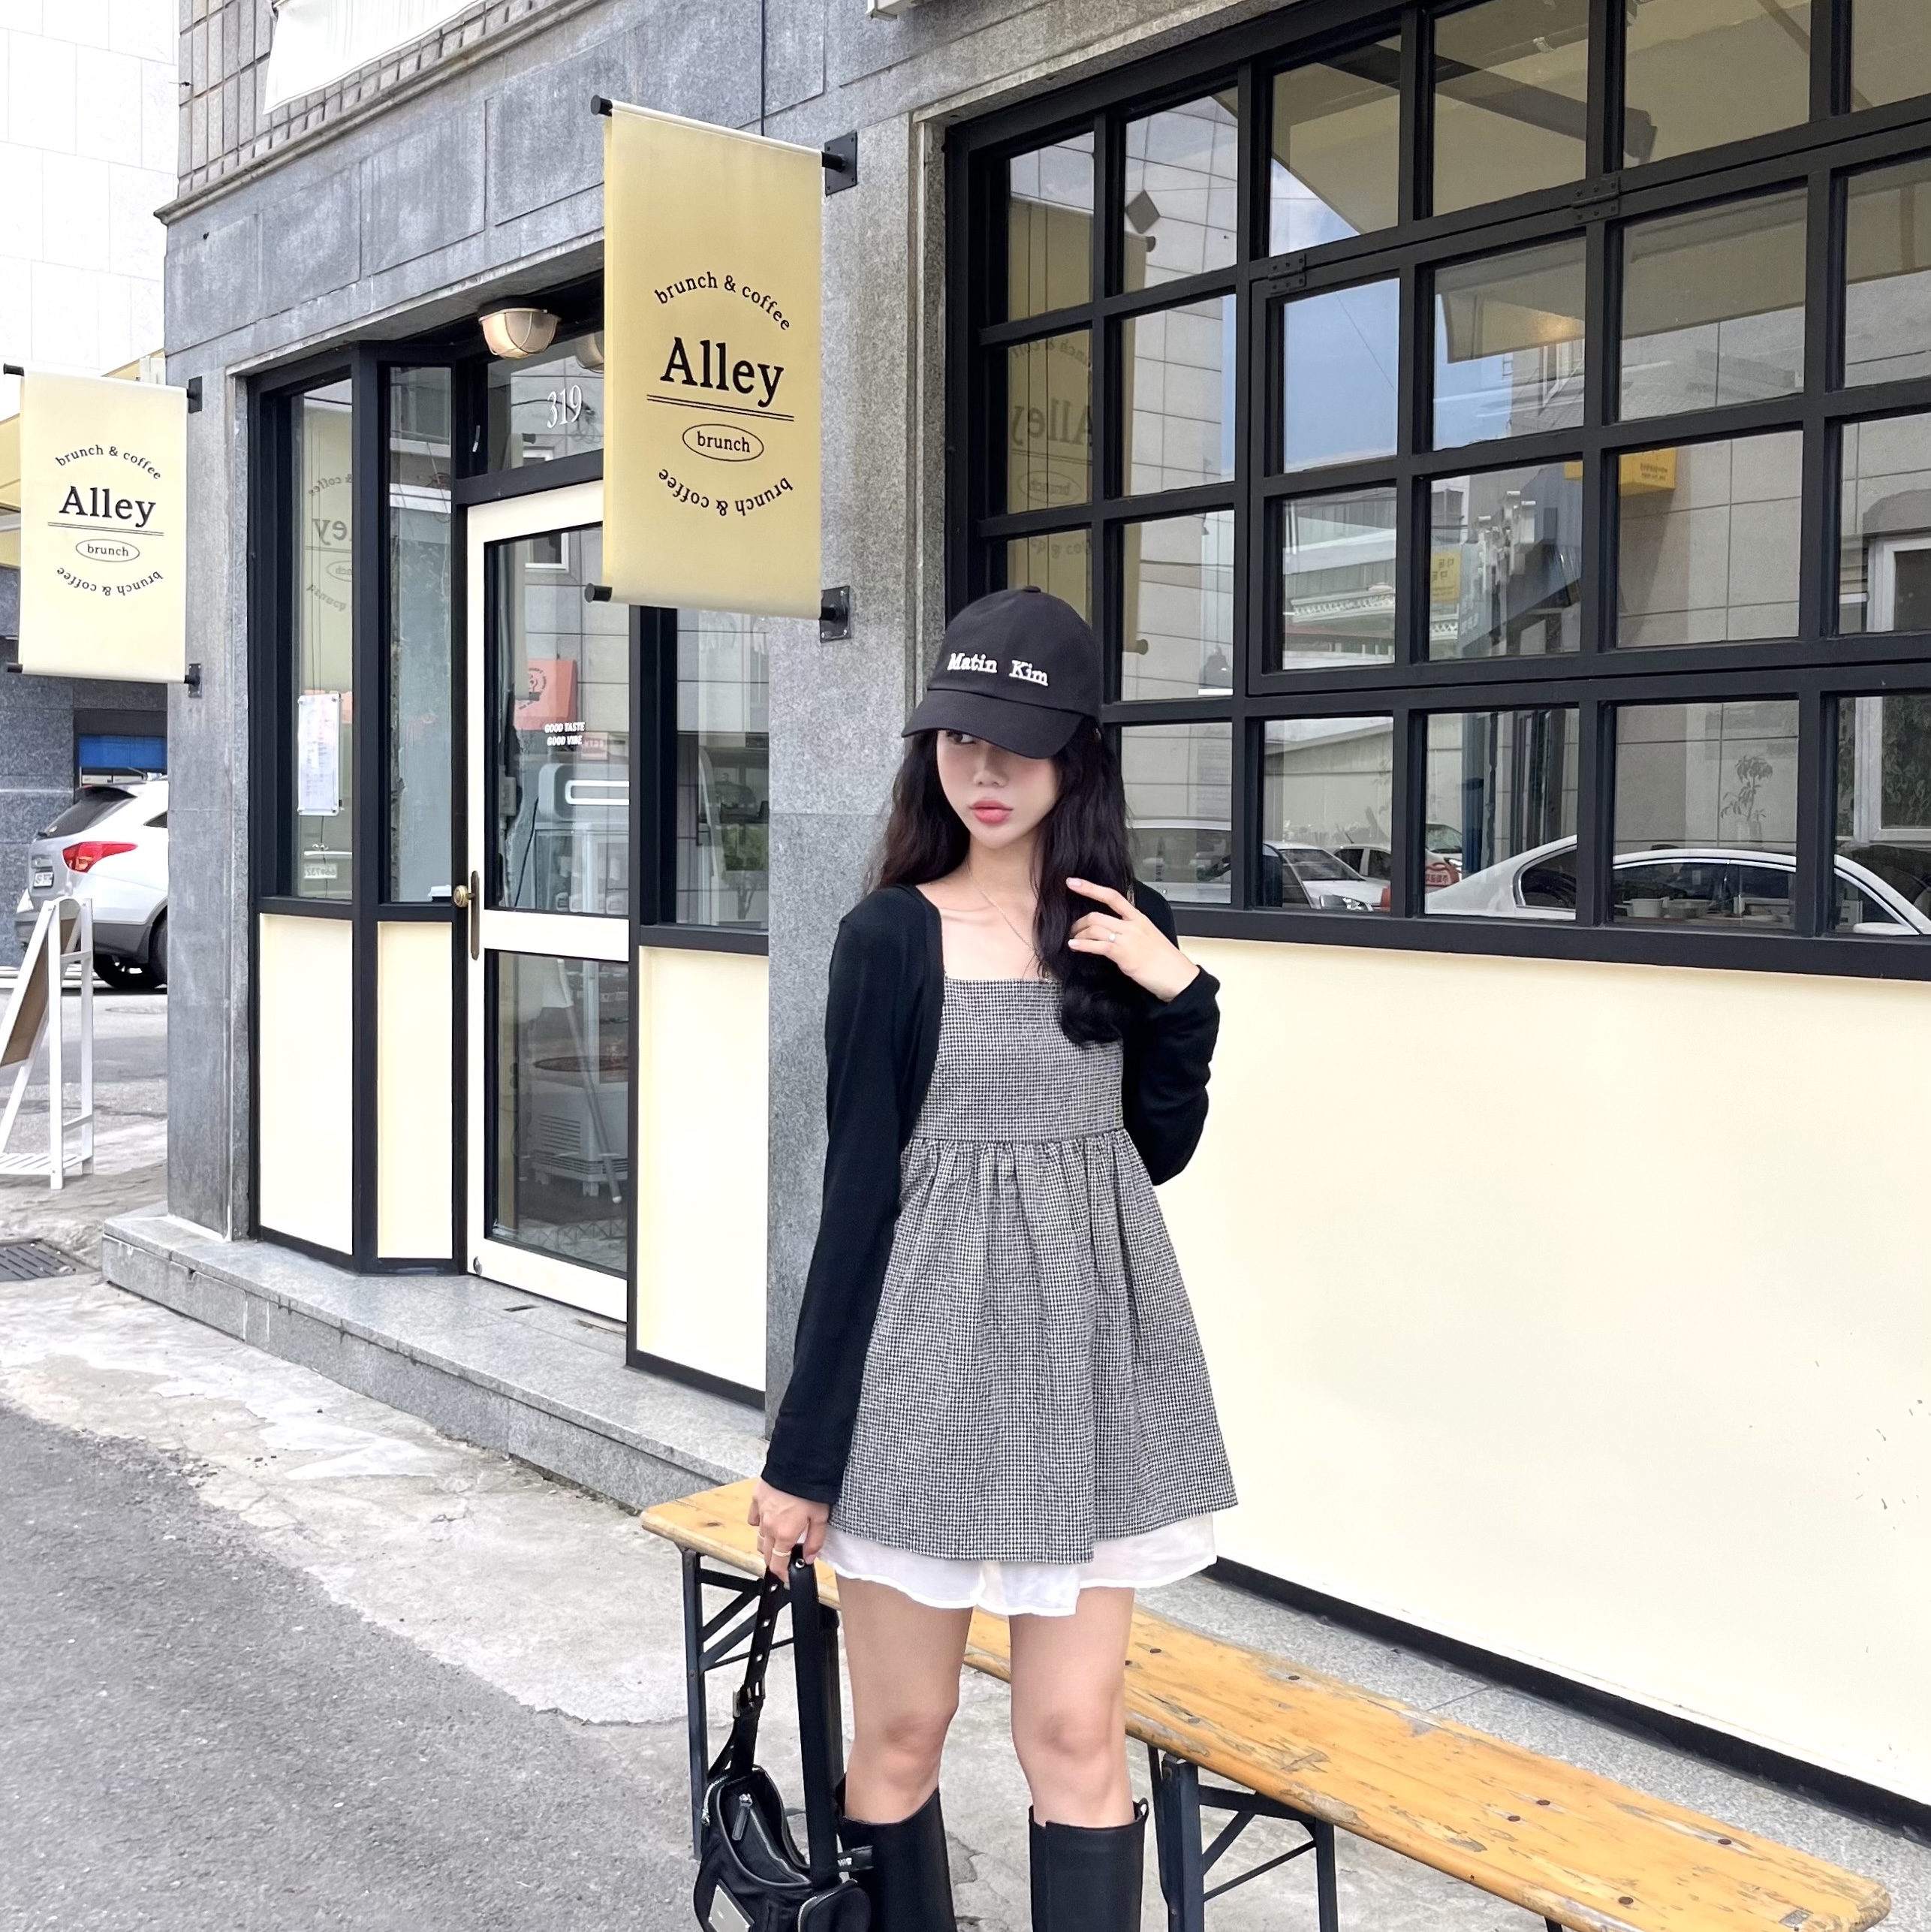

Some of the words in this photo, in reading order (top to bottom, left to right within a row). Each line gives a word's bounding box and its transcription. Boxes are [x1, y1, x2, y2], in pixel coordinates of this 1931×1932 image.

[655, 271, 718, 304] brunch
[724, 275, 737, 293] &
[742, 286, 790, 330] coffee
[660, 336, 785, 407] Alley
[547, 384, 582, 428] 319
[697, 430, 751, 453] brunch
[55, 444, 104, 466] brunch
[109, 446, 119, 457] &
[123, 452, 161, 480] coffee
[658, 469, 709, 508] coffee
[734, 477, 794, 517] brunch
[59, 485, 156, 528] Alley
[715, 499, 728, 517] &
[87, 544, 129, 556] brunch
[56, 567, 97, 592] coffee
[102, 586, 112, 596] &
[116, 571, 164, 596] brunch
[947, 653, 998, 674] Matin
[1009, 659, 1049, 686] Kim
[544, 723, 563, 733] GOOD
[565, 722, 586, 732] TASTE
[547, 736, 566, 746] GOOD
[567, 735, 583, 745] VIBE
